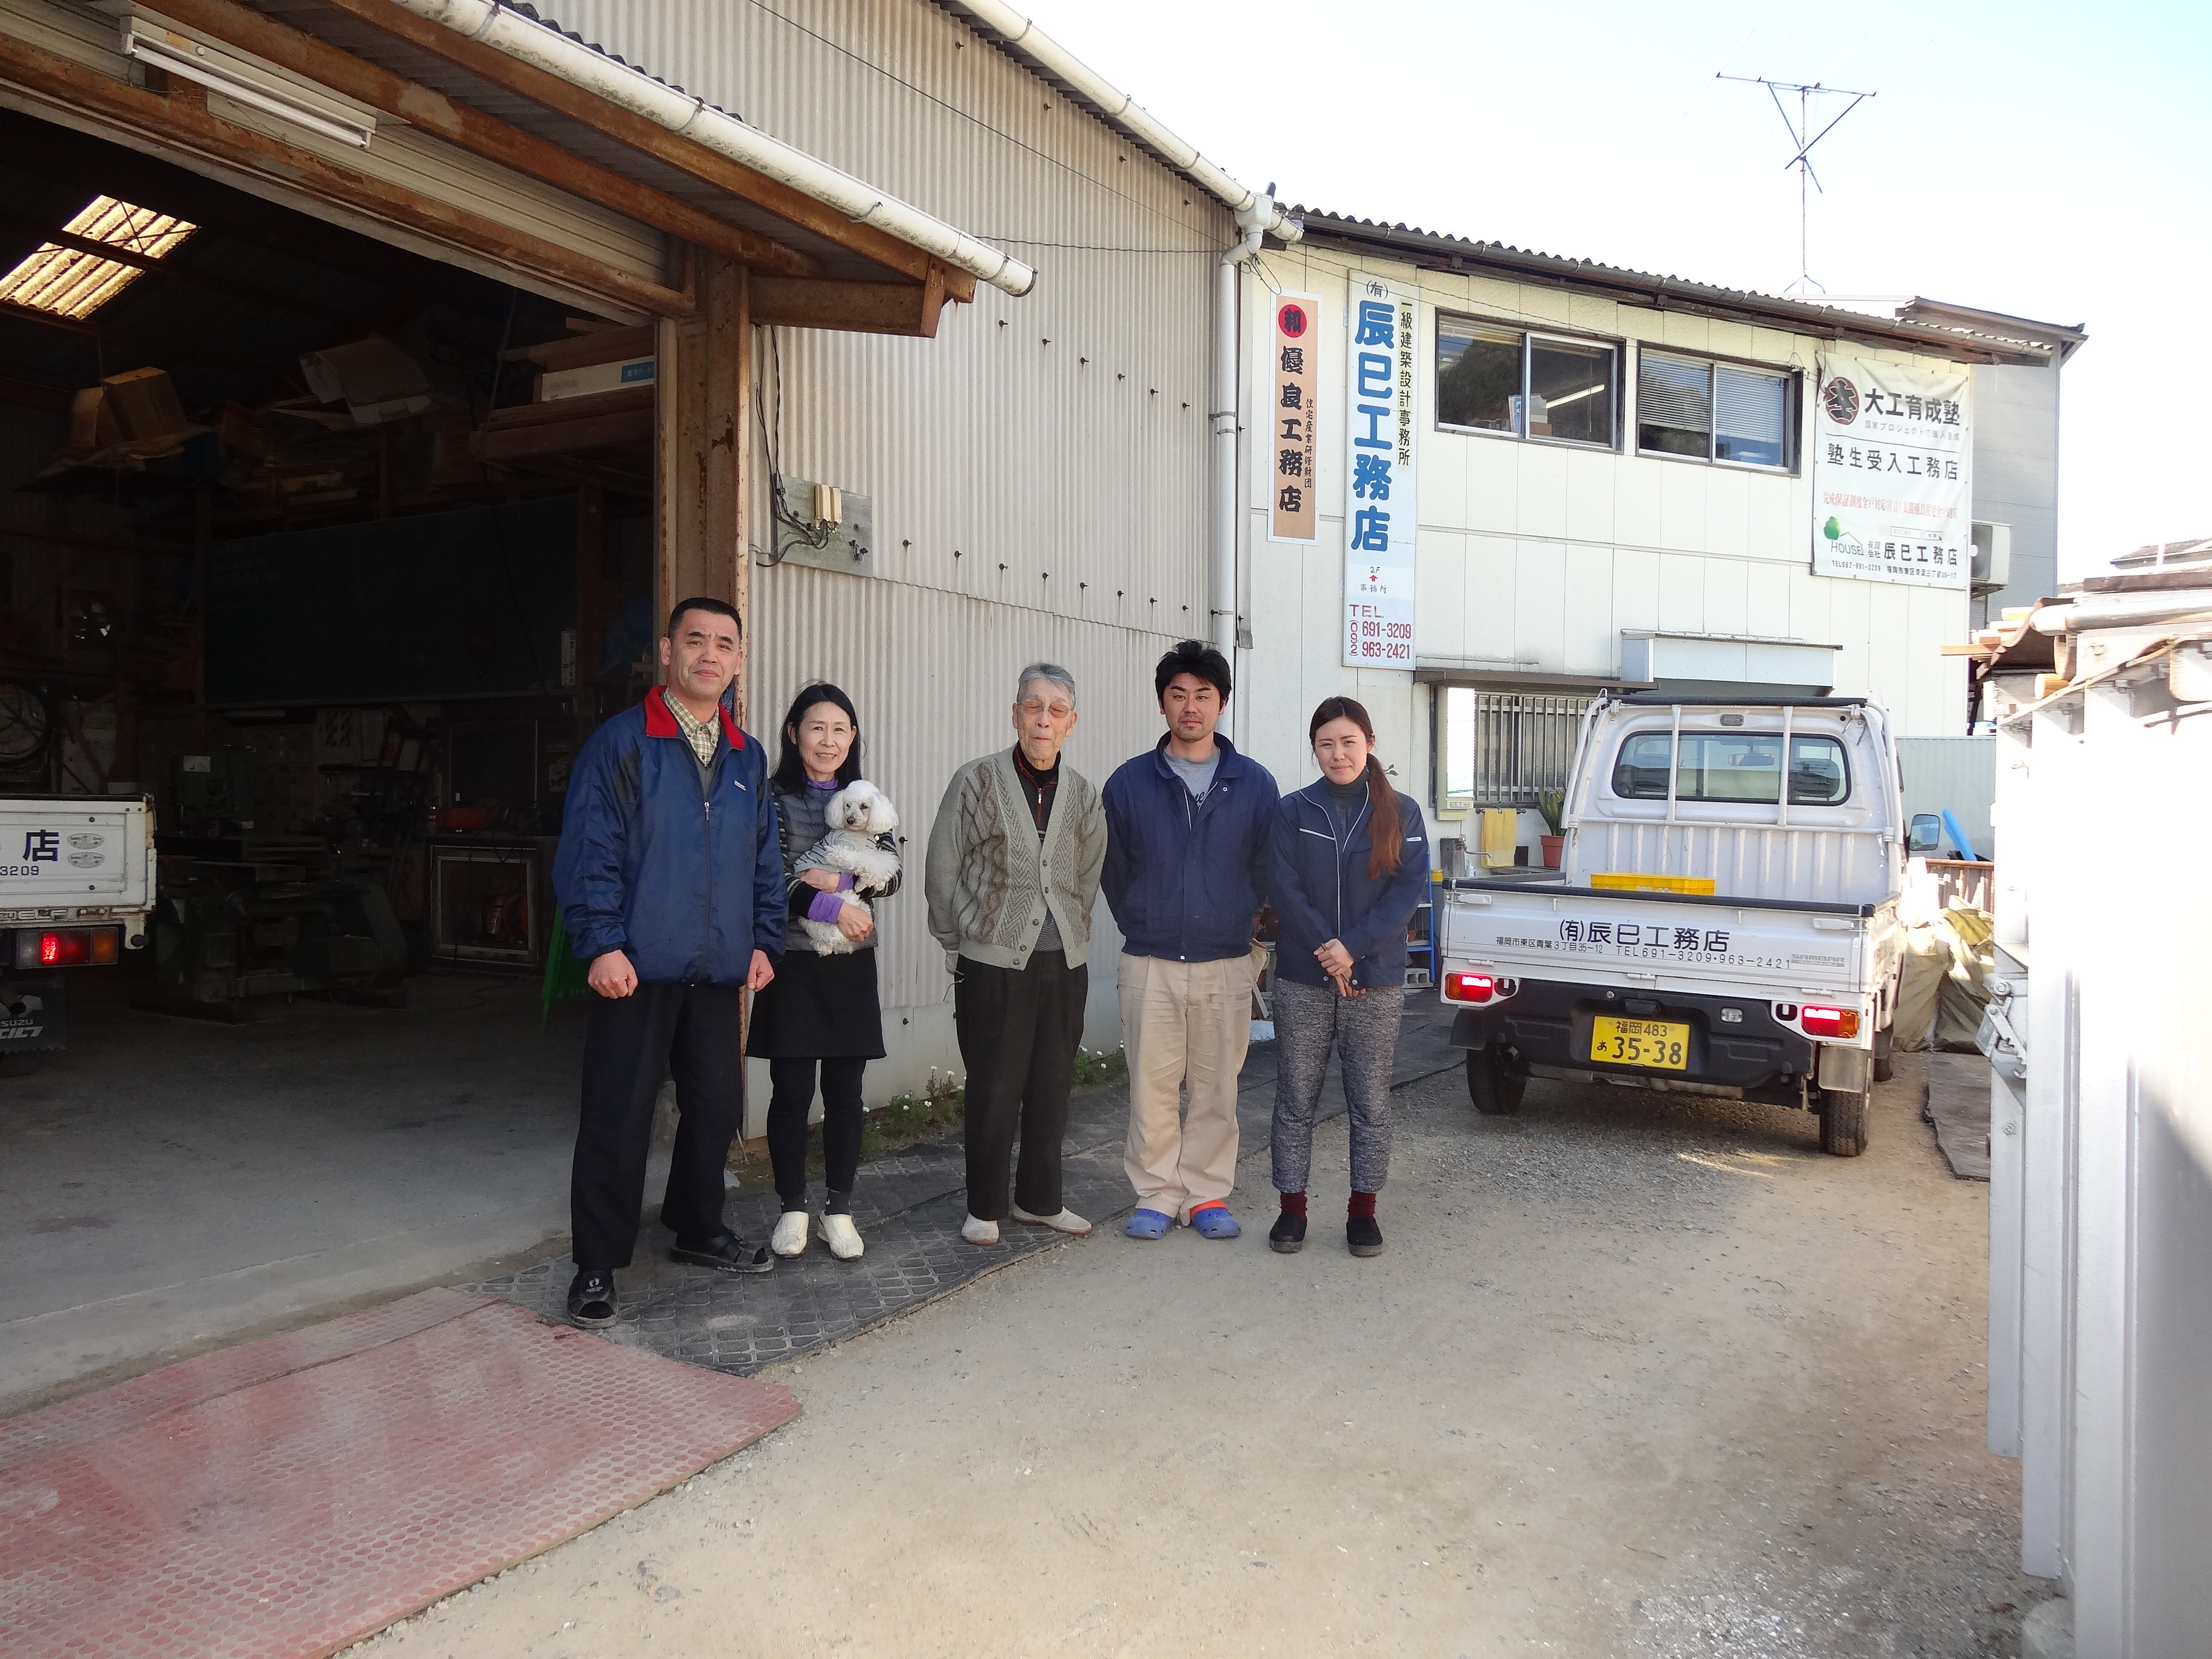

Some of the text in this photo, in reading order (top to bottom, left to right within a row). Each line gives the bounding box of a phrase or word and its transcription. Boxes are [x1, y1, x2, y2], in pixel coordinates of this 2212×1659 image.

[1398, 302, 1413, 466] 一級建築設計事務所
[1864, 387, 1960, 426] 大工育成塾
[1278, 345, 1304, 513] 優良工務店
[1350, 300, 1395, 552] 辰巳工務店
[1304, 398, 1313, 489] 住宅産業研修財団
[1827, 443, 1958, 481] 塾生受入工務店
[1831, 541, 1864, 556] HOUSE
[1884, 542, 1957, 566] 辰巳工務店
[1360, 583, 1387, 594] 事務所
[1349, 604, 1384, 618] TEL
[1362, 620, 1412, 638] 691-3209
[1362, 641, 1410, 659] 963-2421
[22, 830, 59, 862] 店
[1791, 954, 1845, 962] SAMBAR
[1597, 1036, 1682, 1065] あ 35-38
